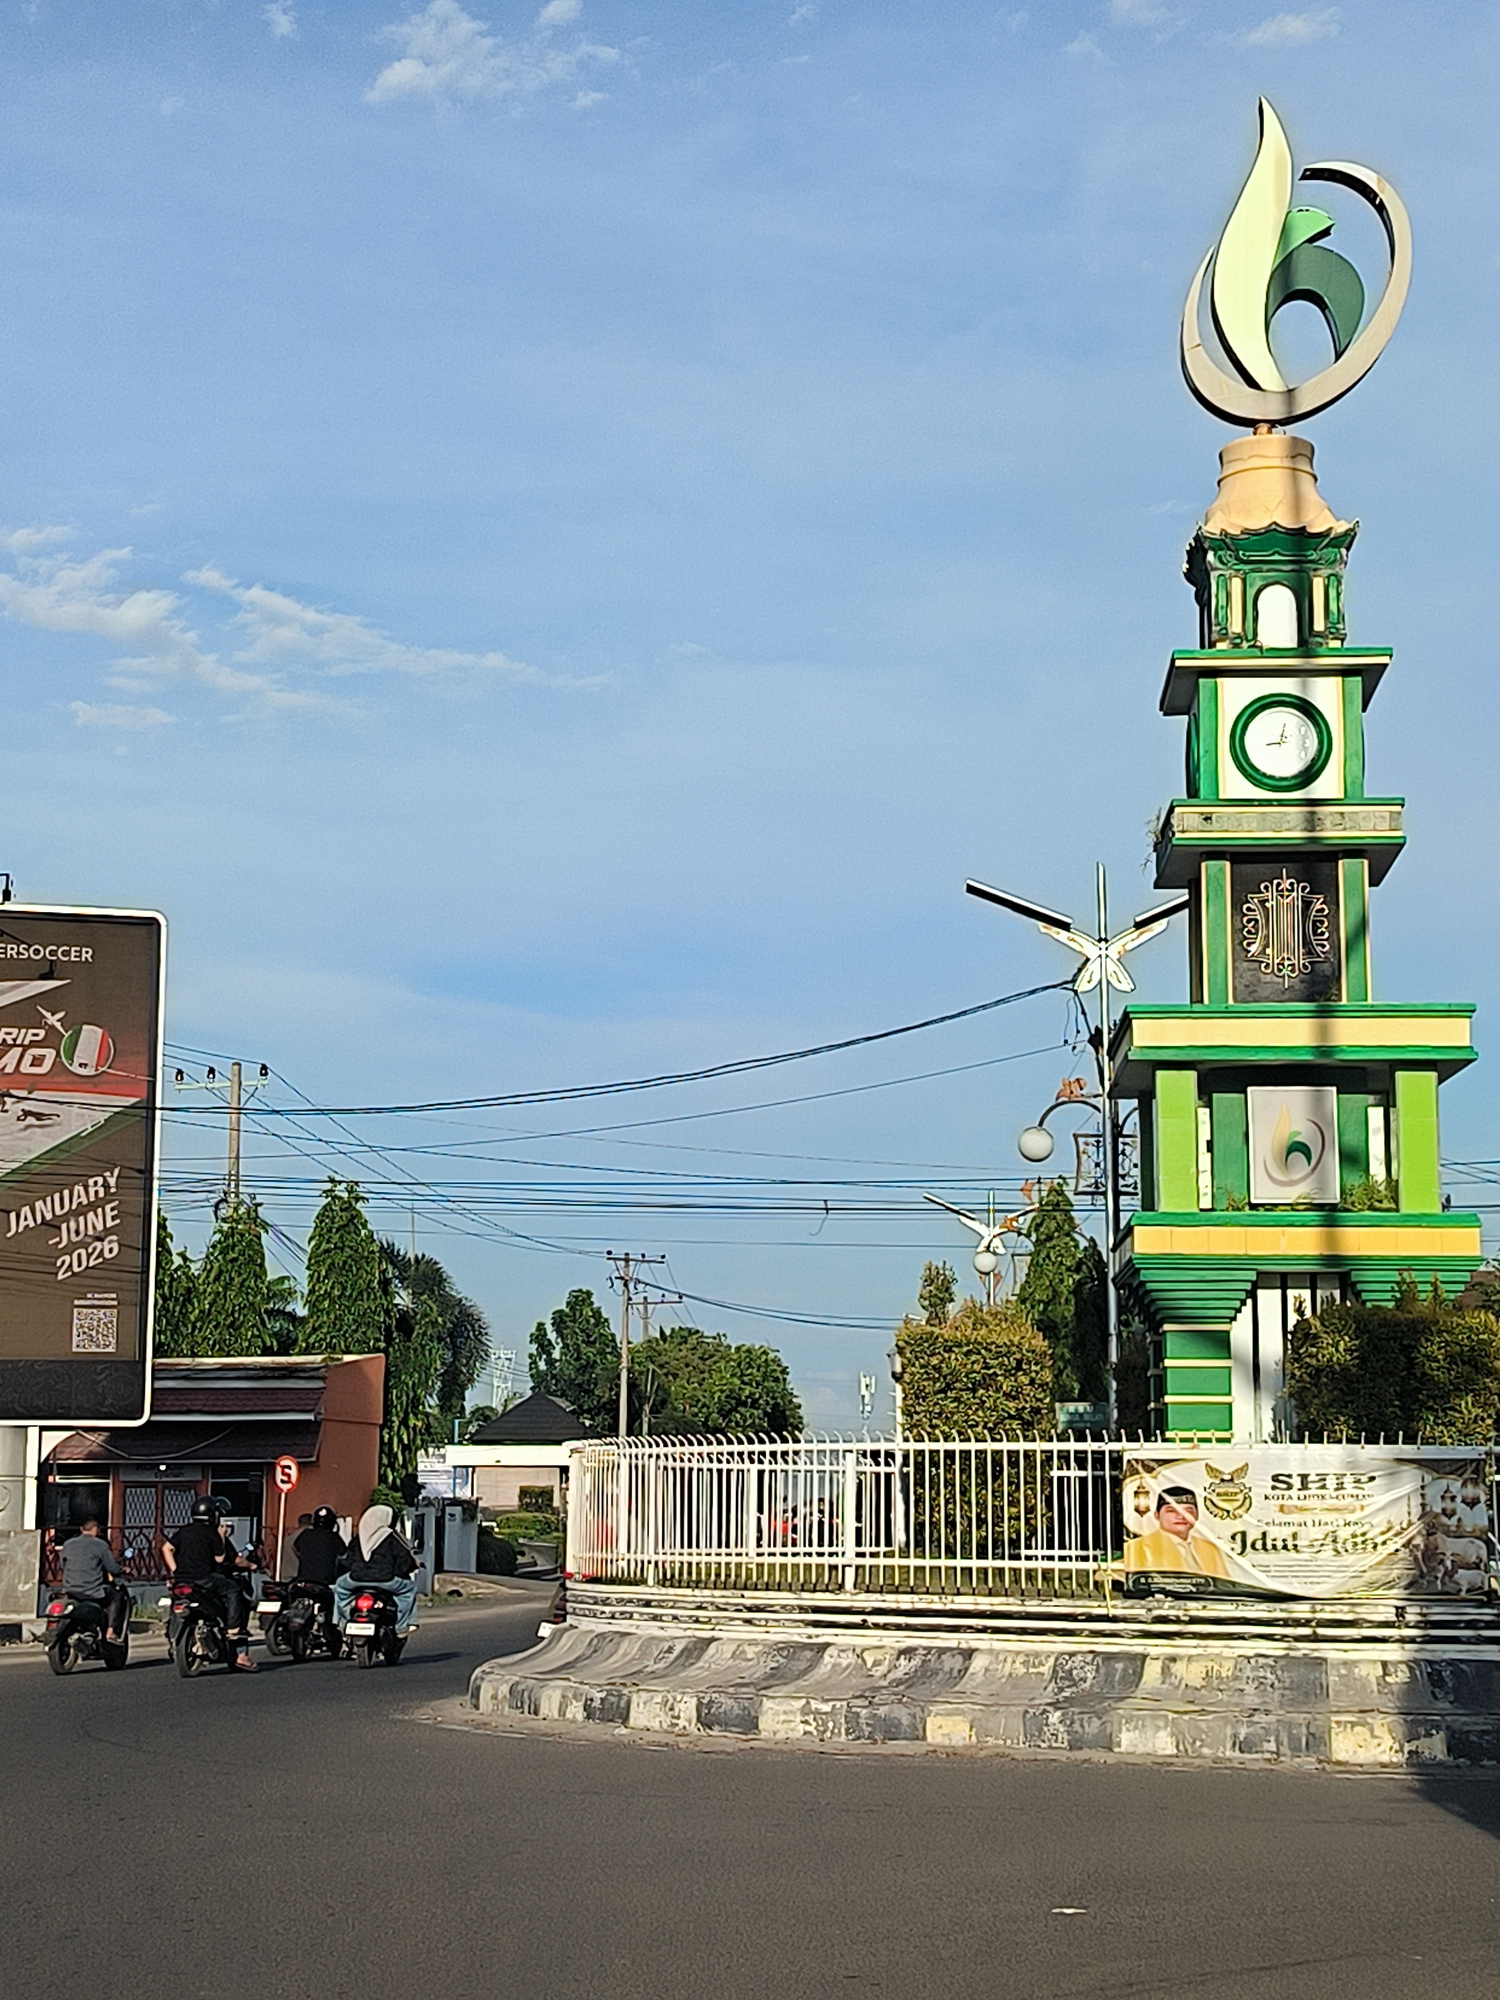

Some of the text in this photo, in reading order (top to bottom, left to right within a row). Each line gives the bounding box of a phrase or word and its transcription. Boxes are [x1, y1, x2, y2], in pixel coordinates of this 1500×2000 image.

[6, 1166, 120, 1238] JANUARY
[56, 1235, 119, 1281] 2026
[1264, 1493, 1294, 1501] KOTA
